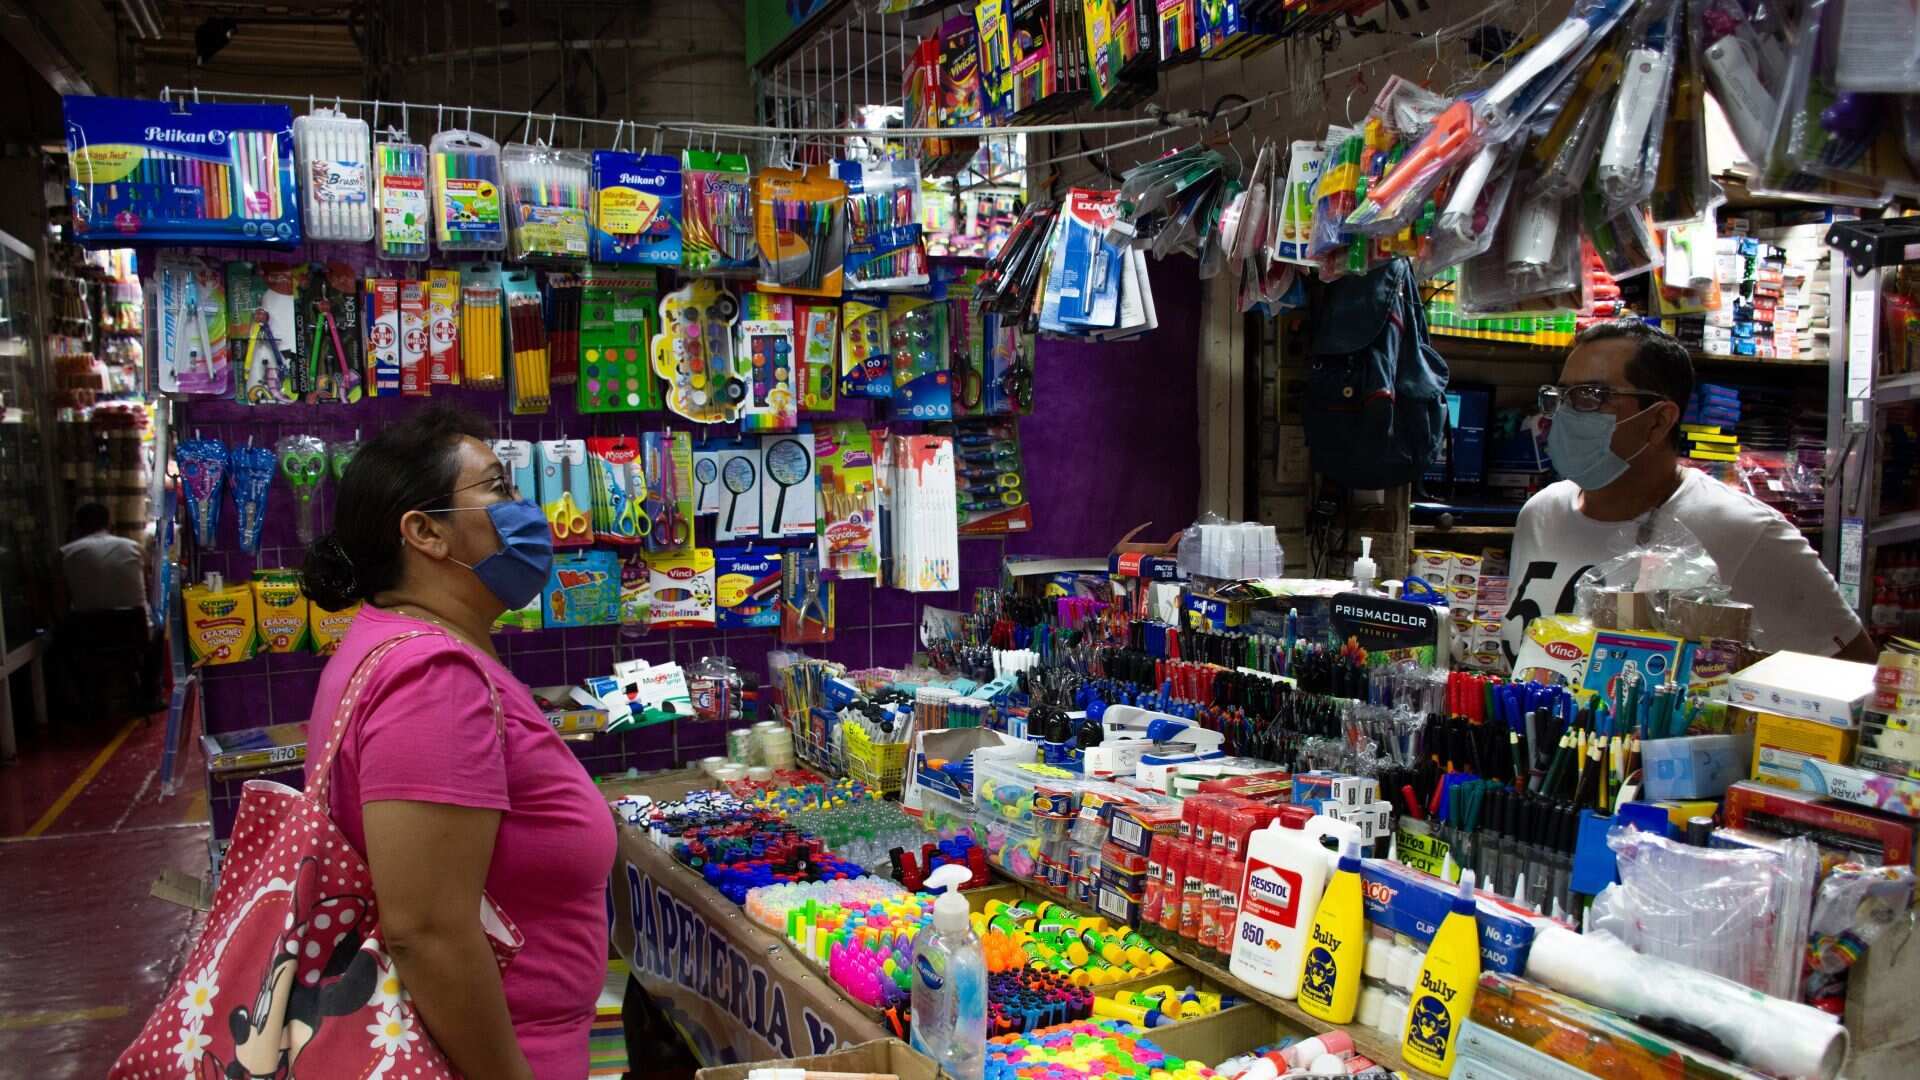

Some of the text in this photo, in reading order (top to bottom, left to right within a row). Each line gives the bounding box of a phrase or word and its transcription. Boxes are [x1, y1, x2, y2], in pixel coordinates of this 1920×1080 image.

[144, 126, 206, 144] Pelikan
[619, 172, 655, 185] Pelikan
[605, 450, 634, 461] Maped
[669, 570, 692, 578] Vinci
[731, 562, 760, 571] Pelikan
[262, 590, 297, 600] Crayola
[200, 600, 237, 609] Crayola
[650, 609, 700, 618] Modelina
[1335, 604, 1427, 628] PRISMACOLOR
[1549, 644, 1578, 658] Vinci
[1251, 875, 1287, 898] RESISTOL
[1242, 921, 1264, 946] 850
[1416, 920, 1436, 935] CLIP
[1312, 922, 1342, 952] Bully
[1485, 925, 1513, 946] No. 2
[626, 860, 795, 1059] PAPELERIA
[1420, 968, 1457, 1002] Bully
